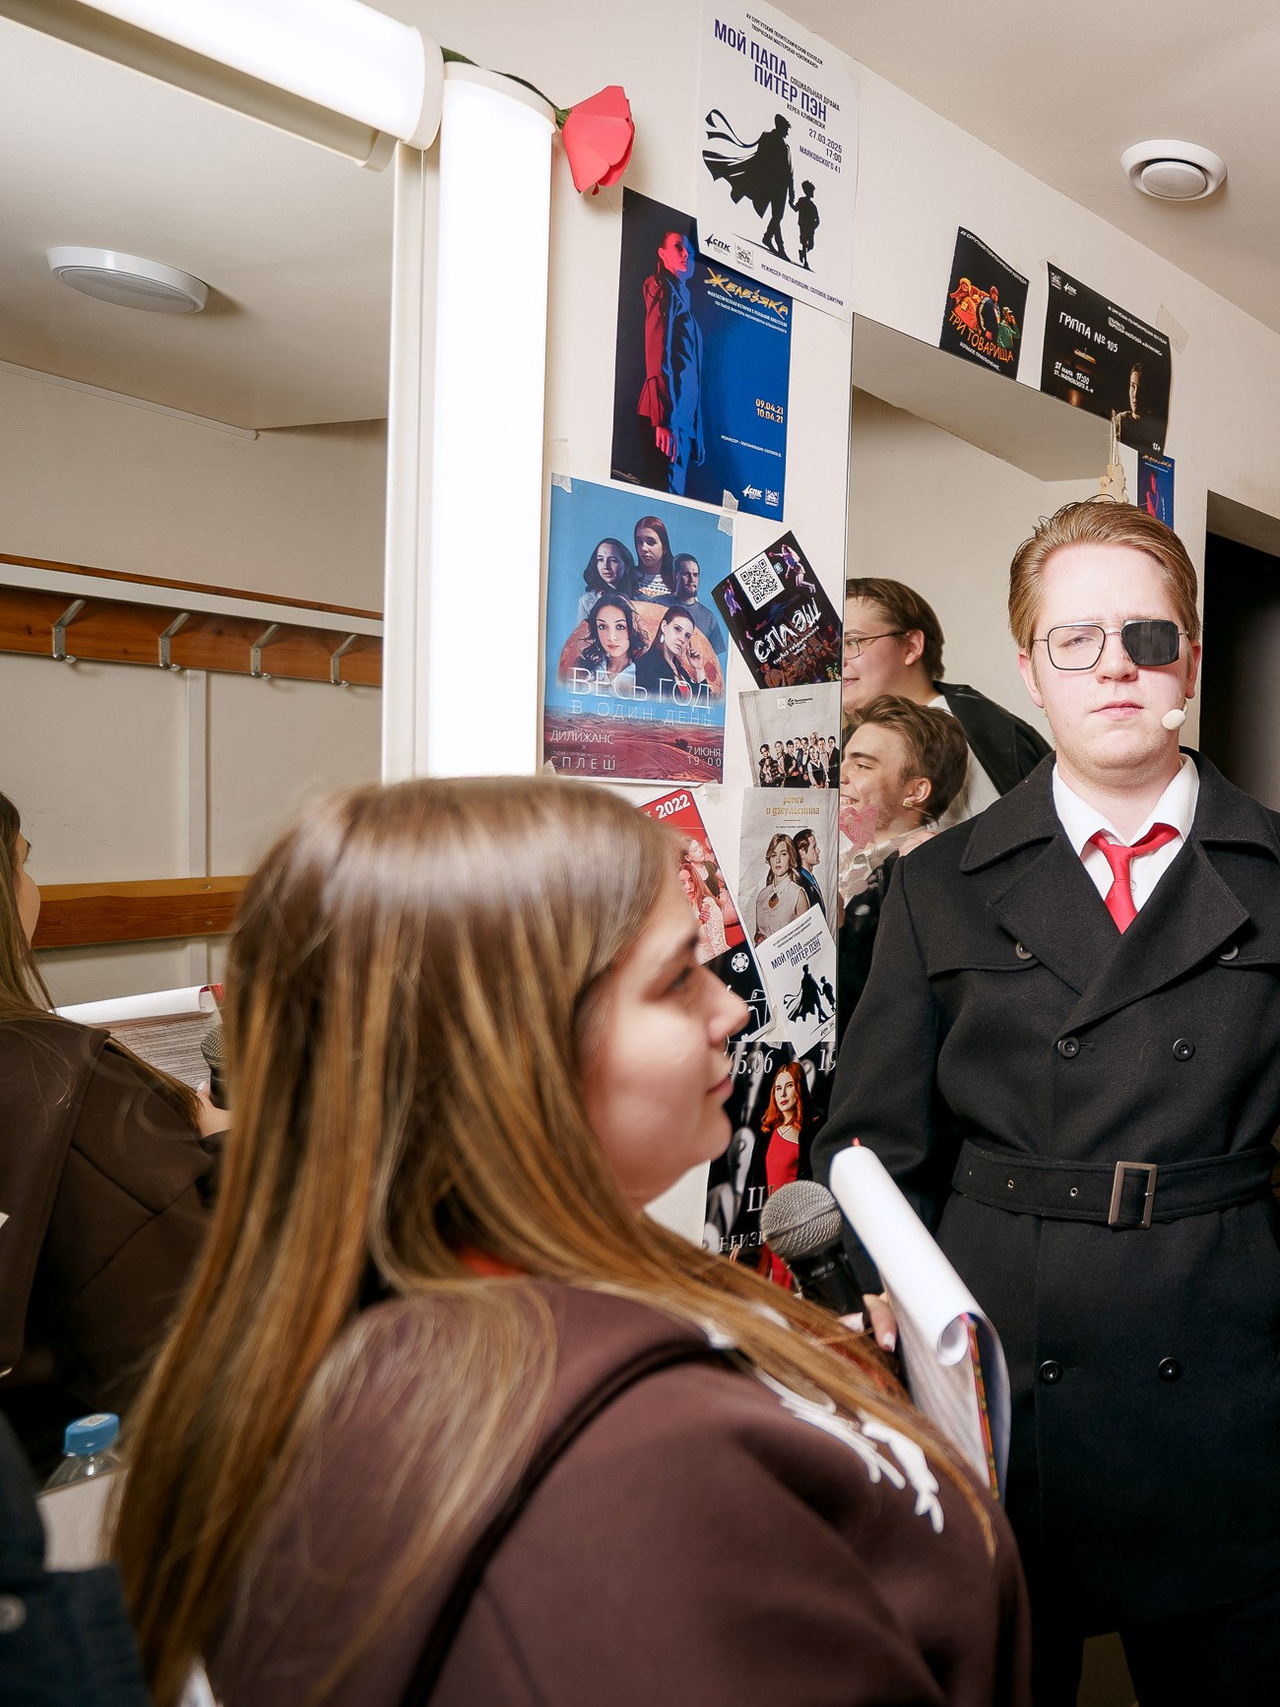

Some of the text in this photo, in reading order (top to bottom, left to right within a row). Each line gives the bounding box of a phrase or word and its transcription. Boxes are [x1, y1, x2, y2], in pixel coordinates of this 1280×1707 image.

[714, 18, 788, 80] МОЙ ПАПА
[754, 63, 827, 122] ПИТЕР ПЭН
[808, 128, 843, 154] 27.03.2025
[799, 145, 834, 170] МАЯКОВСКОГО
[826, 148, 842, 163] 17:00
[712, 238, 732, 252] СПК
[704, 267, 789, 320] ЖЕЛЕЗЯКА
[949, 310, 1014, 363] ТРИ ТОВАРИЩА
[1059, 311, 1091, 339] ГРУППА
[1106, 340, 1119, 353] 105
[570, 666, 716, 714] ВЕСЬ ГОД
[570, 700, 714, 727] В ОДИН ДЕНЬ
[549, 729, 615, 745] ДИЛИЖАНС
[550, 756, 616, 771] СПЛЕШ
[687, 745, 722, 757] 7 ИЮНЯ
[687, 756, 722, 767] 19:00
[655, 794, 691, 820] 2022
[770, 953, 787, 970] МОЙ
[785, 941, 803, 961] ПАПА
[790, 950, 809, 967] ПИТЕР
[809, 938, 822, 954] ПЭН
[718, 1230, 764, 1252] НЕИЗ
